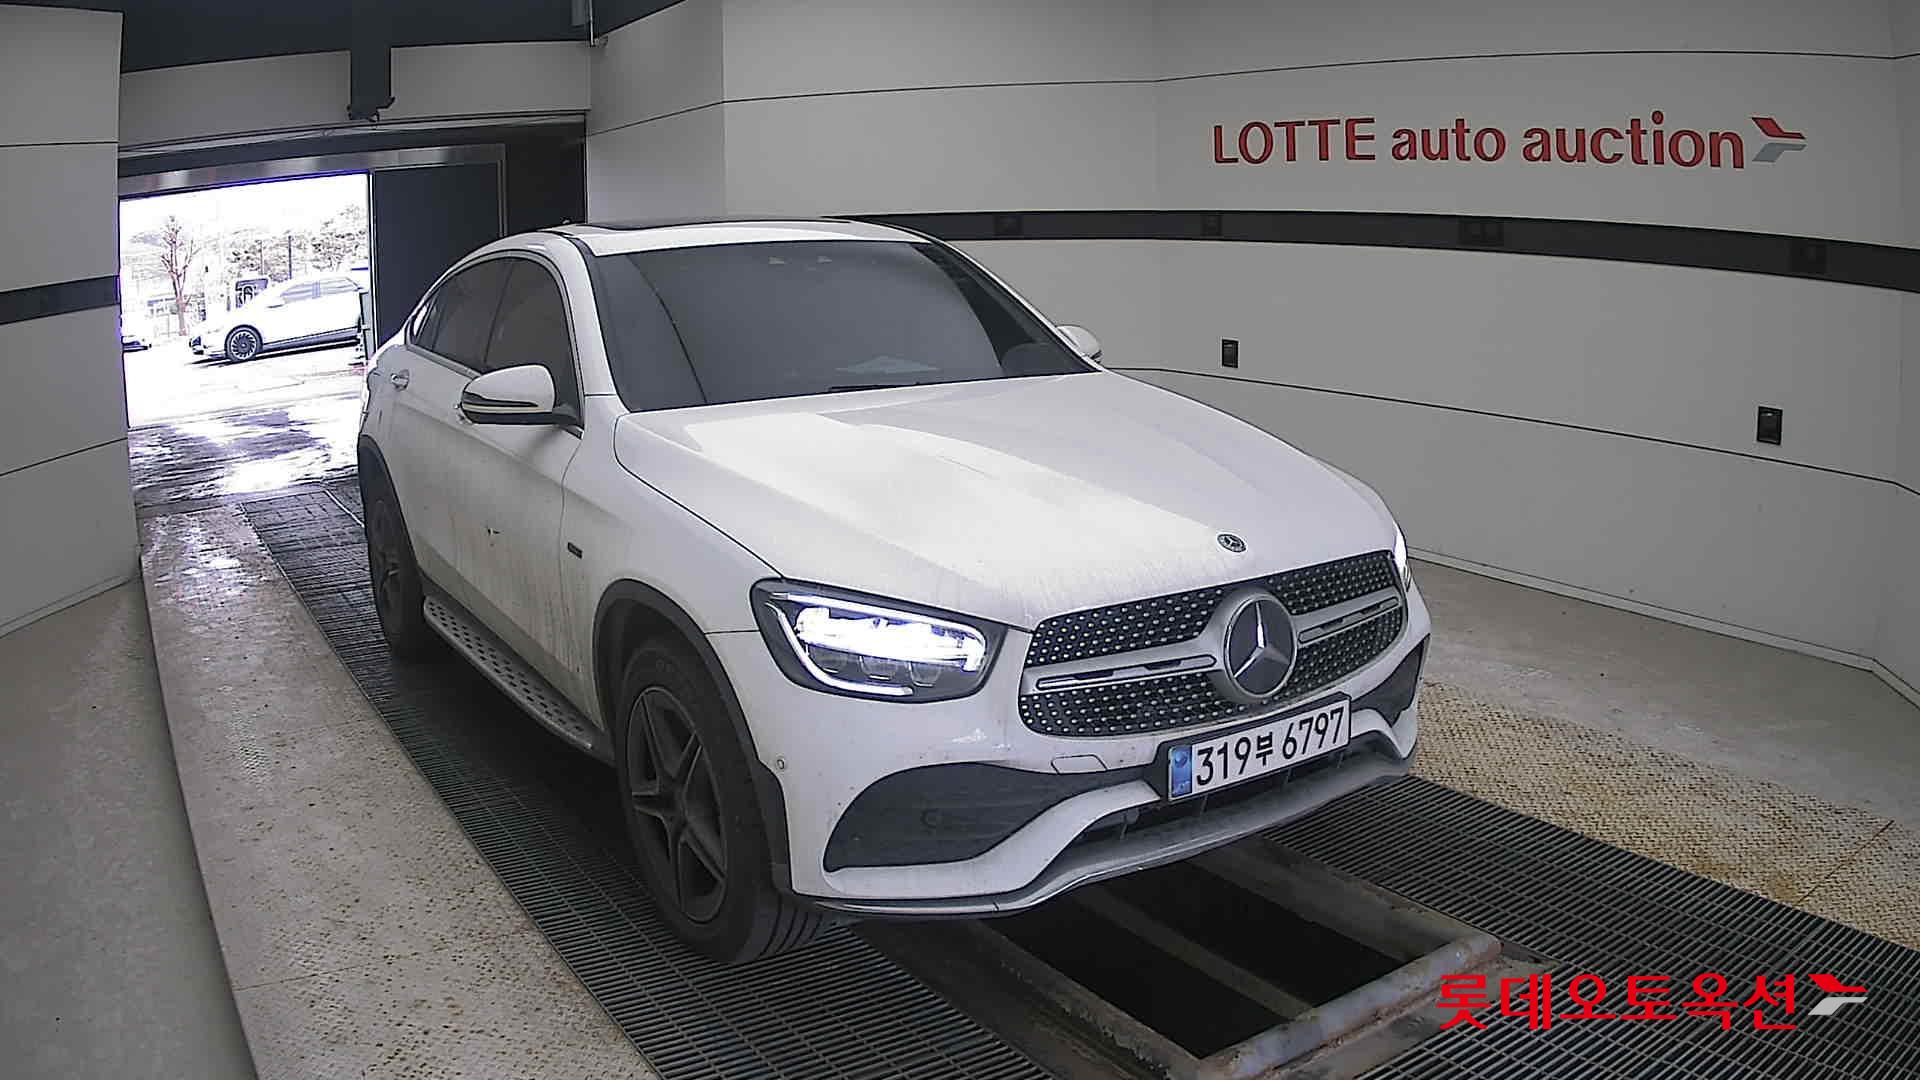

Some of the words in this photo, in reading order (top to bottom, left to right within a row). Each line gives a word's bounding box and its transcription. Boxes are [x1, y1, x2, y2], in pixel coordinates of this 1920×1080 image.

[1213, 117, 1376, 165] LOTTE
[1391, 118, 1507, 162] auto
[1522, 110, 1745, 169] auction
[1196, 732, 1273, 786] 319부
[1282, 706, 1345, 760] 6797
